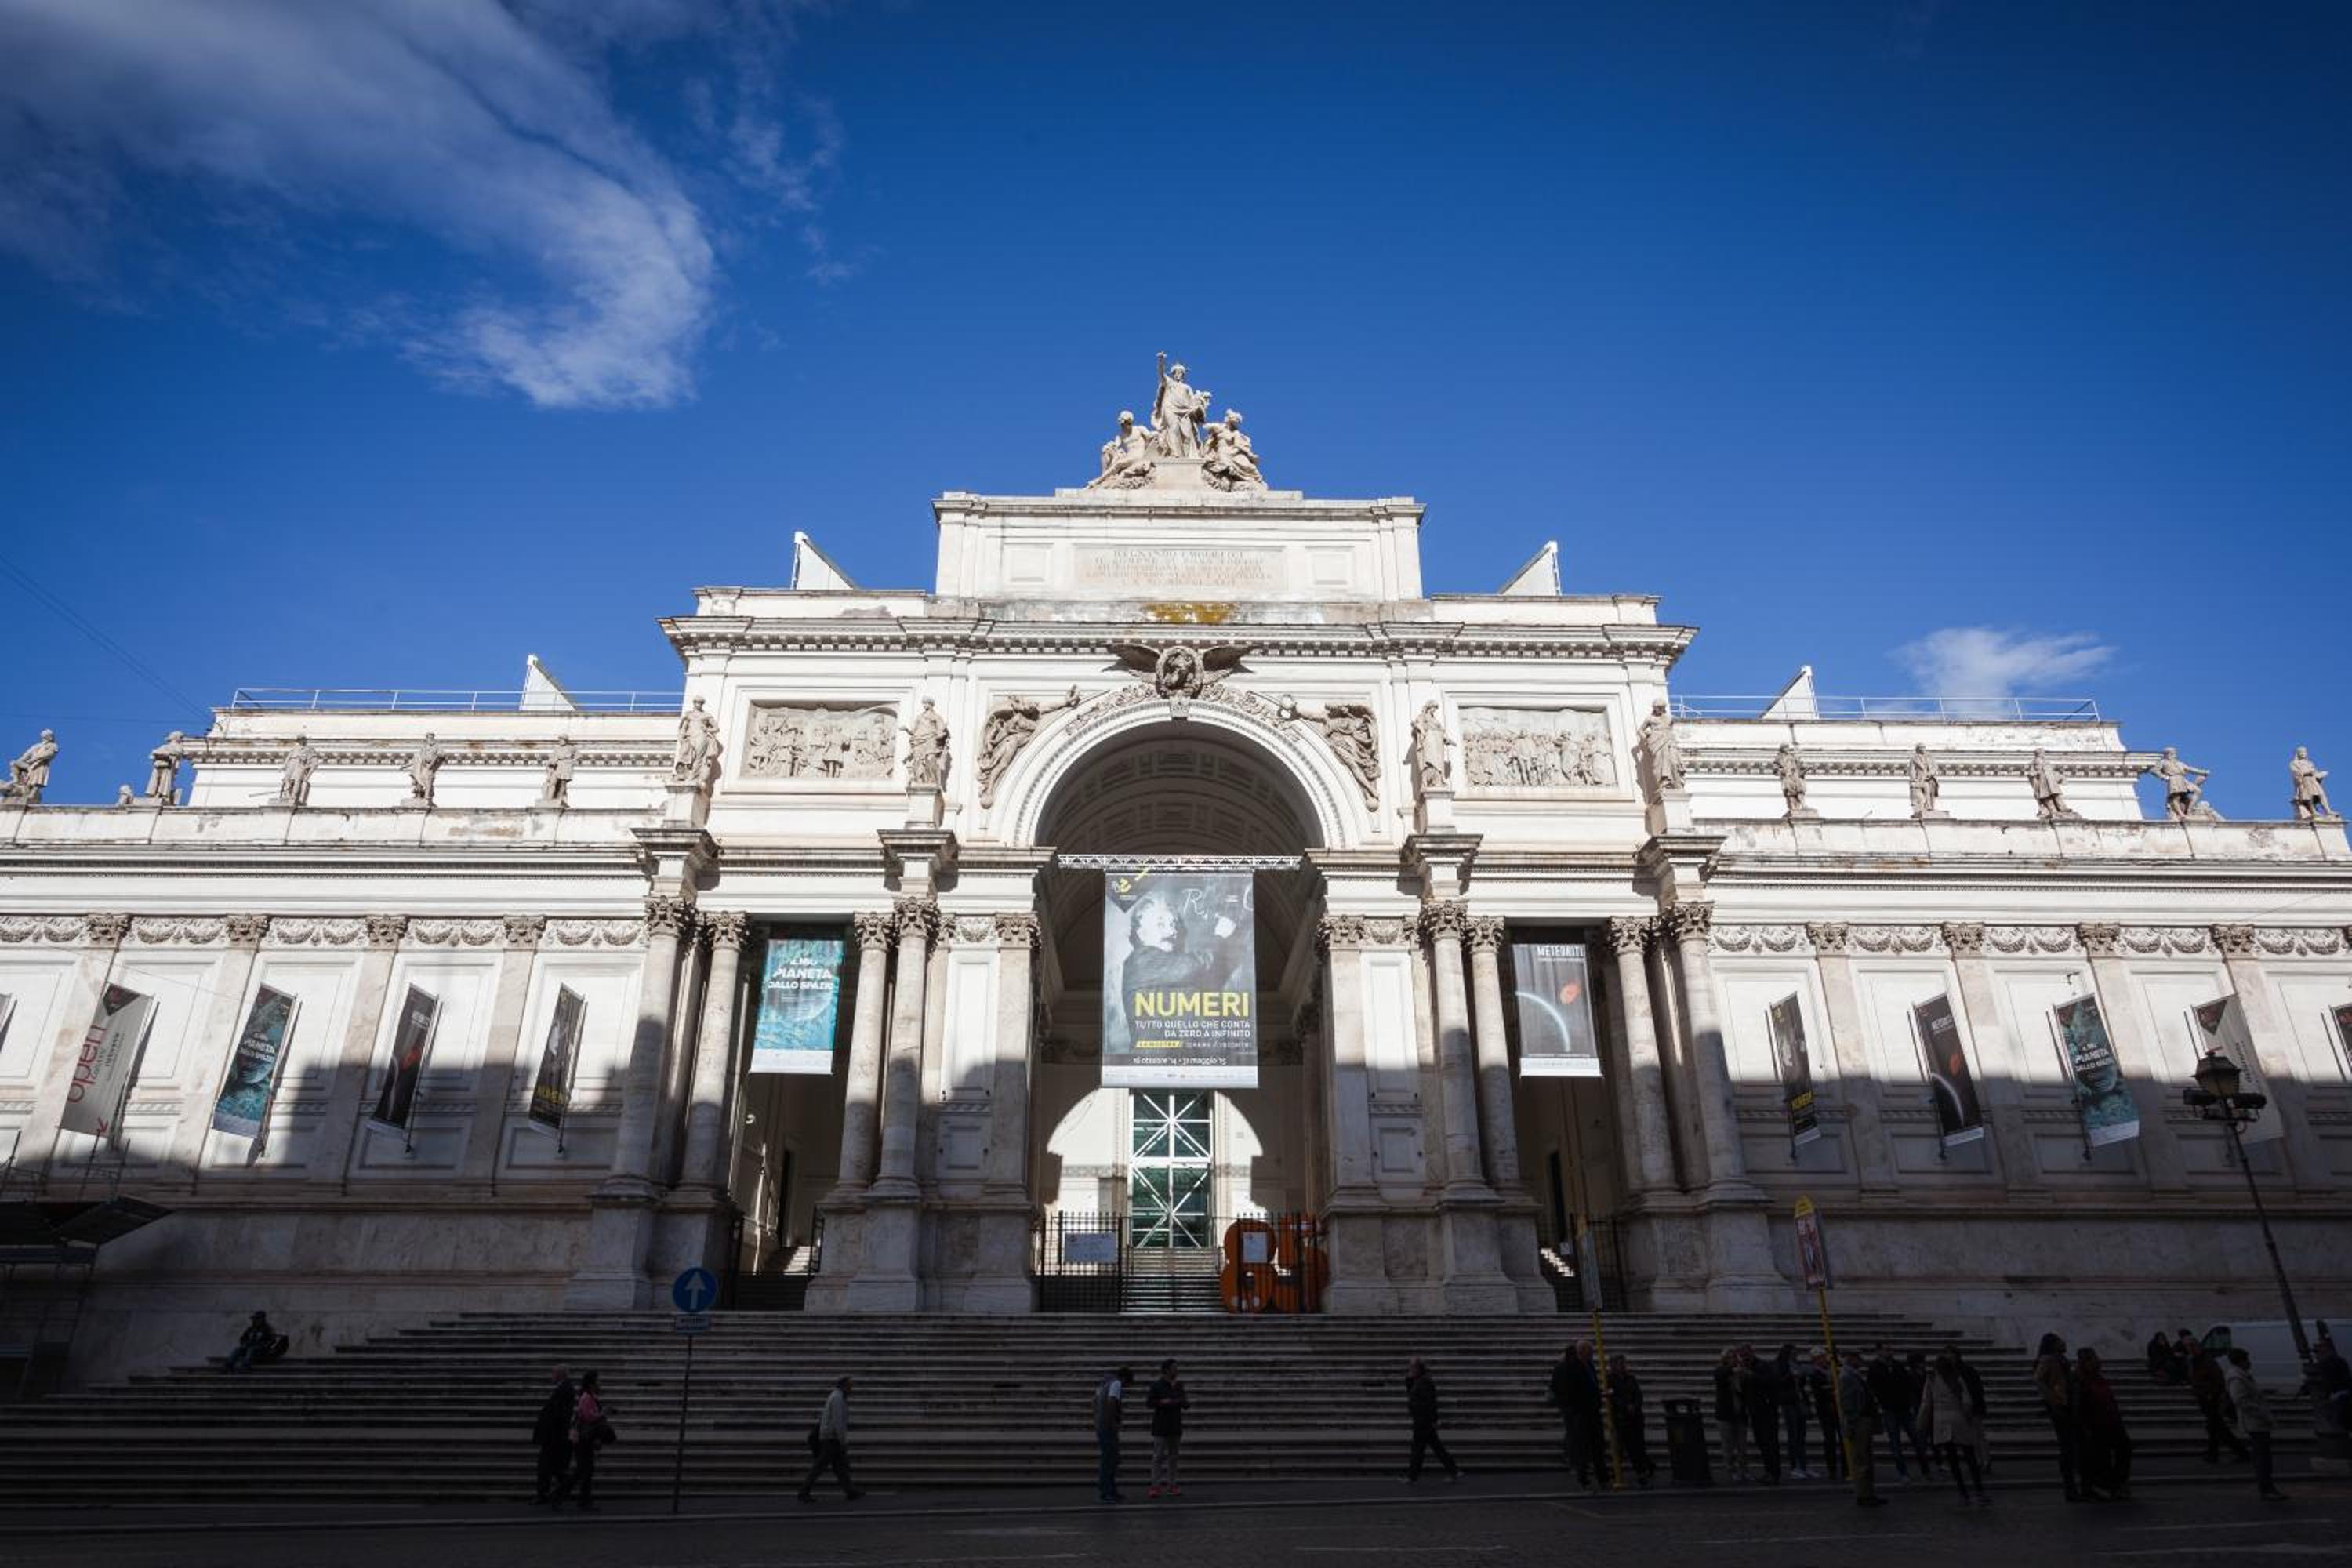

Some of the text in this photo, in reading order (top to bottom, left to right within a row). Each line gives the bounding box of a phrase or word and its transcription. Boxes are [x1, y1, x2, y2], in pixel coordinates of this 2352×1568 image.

[772, 967, 833, 979] PIANETA
[800, 981, 833, 990] SPAZIO
[1134, 991, 1250, 1017] NUMERI
[67, 1025, 107, 1103] open
[1190, 1056, 1218, 1065] maggio
